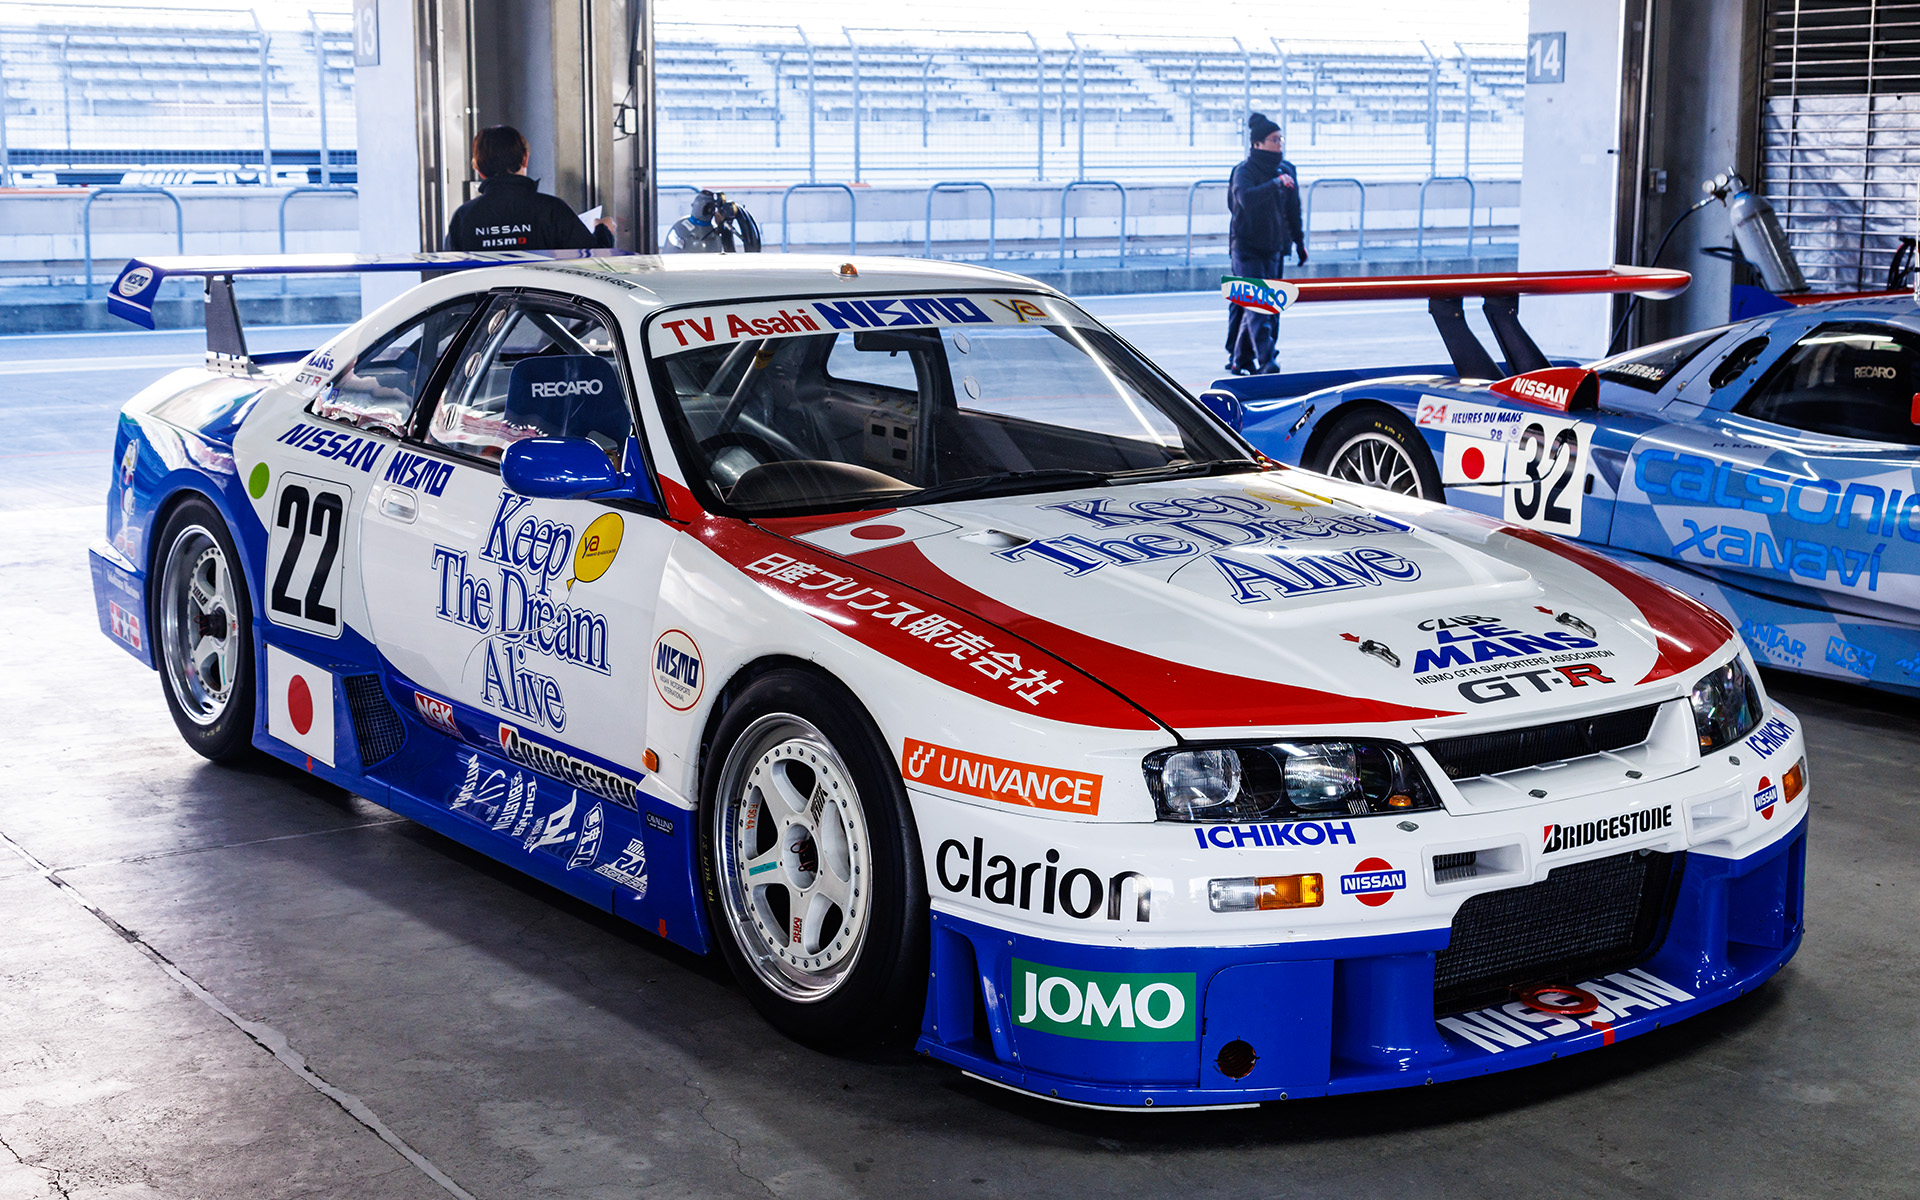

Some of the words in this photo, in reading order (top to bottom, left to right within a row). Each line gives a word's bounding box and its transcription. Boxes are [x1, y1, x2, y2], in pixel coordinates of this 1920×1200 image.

[355, 8, 375, 56] 13
[1530, 39, 1561, 77] 14
[475, 224, 532, 236] NISSAN
[482, 237, 527, 248] nismo
[811, 297, 993, 329] NISMO
[1229, 282, 1288, 309] MEXICO
[661, 316, 716, 347] TV
[725, 308, 821, 338] Asahi
[531, 379, 603, 398] RECARO
[1511, 377, 1570, 405] NISSAN
[1854, 366, 1897, 379] RECARO
[1418, 404, 1449, 424] 24
[1451, 412, 1482, 424] HEURES
[1484, 412, 1496, 423] DU
[1497, 412, 1524, 423] MANS
[277, 423, 386, 473] NISSAN
[1490, 429, 1503, 441] 98
[384, 450, 456, 498] NISMO
[1513, 421, 1578, 525] 32
[1036, 495, 1273, 531] Keep
[271, 485, 344, 628] 22
[479, 487, 575, 600] Keep
[990, 532, 1201, 578] The
[1159, 512, 1417, 551] Dream
[1203, 545, 1422, 605] Alive
[431, 543, 493, 634] The
[496, 563, 611, 677] Dream
[744, 552, 1065, 706] 日産プリンス販売会社
[1417, 614, 1501, 632] CLUB
[1413, 631, 1598, 674] MANS
[1436, 624, 1523, 645] LE
[1738, 619, 1807, 659] ANTAR
[656, 641, 700, 689] NISMO
[1415, 672, 1454, 686] NISMO
[1457, 667, 1482, 679] GT-R
[1483, 657, 1550, 674] SUPPORTERS
[1551, 649, 1615, 664] ASSOCIATION
[1827, 638, 1874, 672] NGK
[480, 637, 567, 734] Alive
[415, 697, 456, 730] NGK
[1745, 716, 1795, 760] ICHIKOH
[450, 754, 478, 810] MITSUBA
[501, 727, 638, 812] BRIDGESTON
[939, 756, 1093, 808] UNIVANCE
[491, 782, 524, 831] BILSTEIN
[1754, 787, 1777, 809] NISSAN
[626, 841, 645, 857] VOL
[1195, 821, 1357, 850] ICHIKOH
[1542, 805, 1672, 855] BRIDGESTONE
[1343, 871, 1405, 894] NISSAN
[1018, 971, 1186, 1030] JOMO
[1435, 967, 1696, 1054] NISSAN
